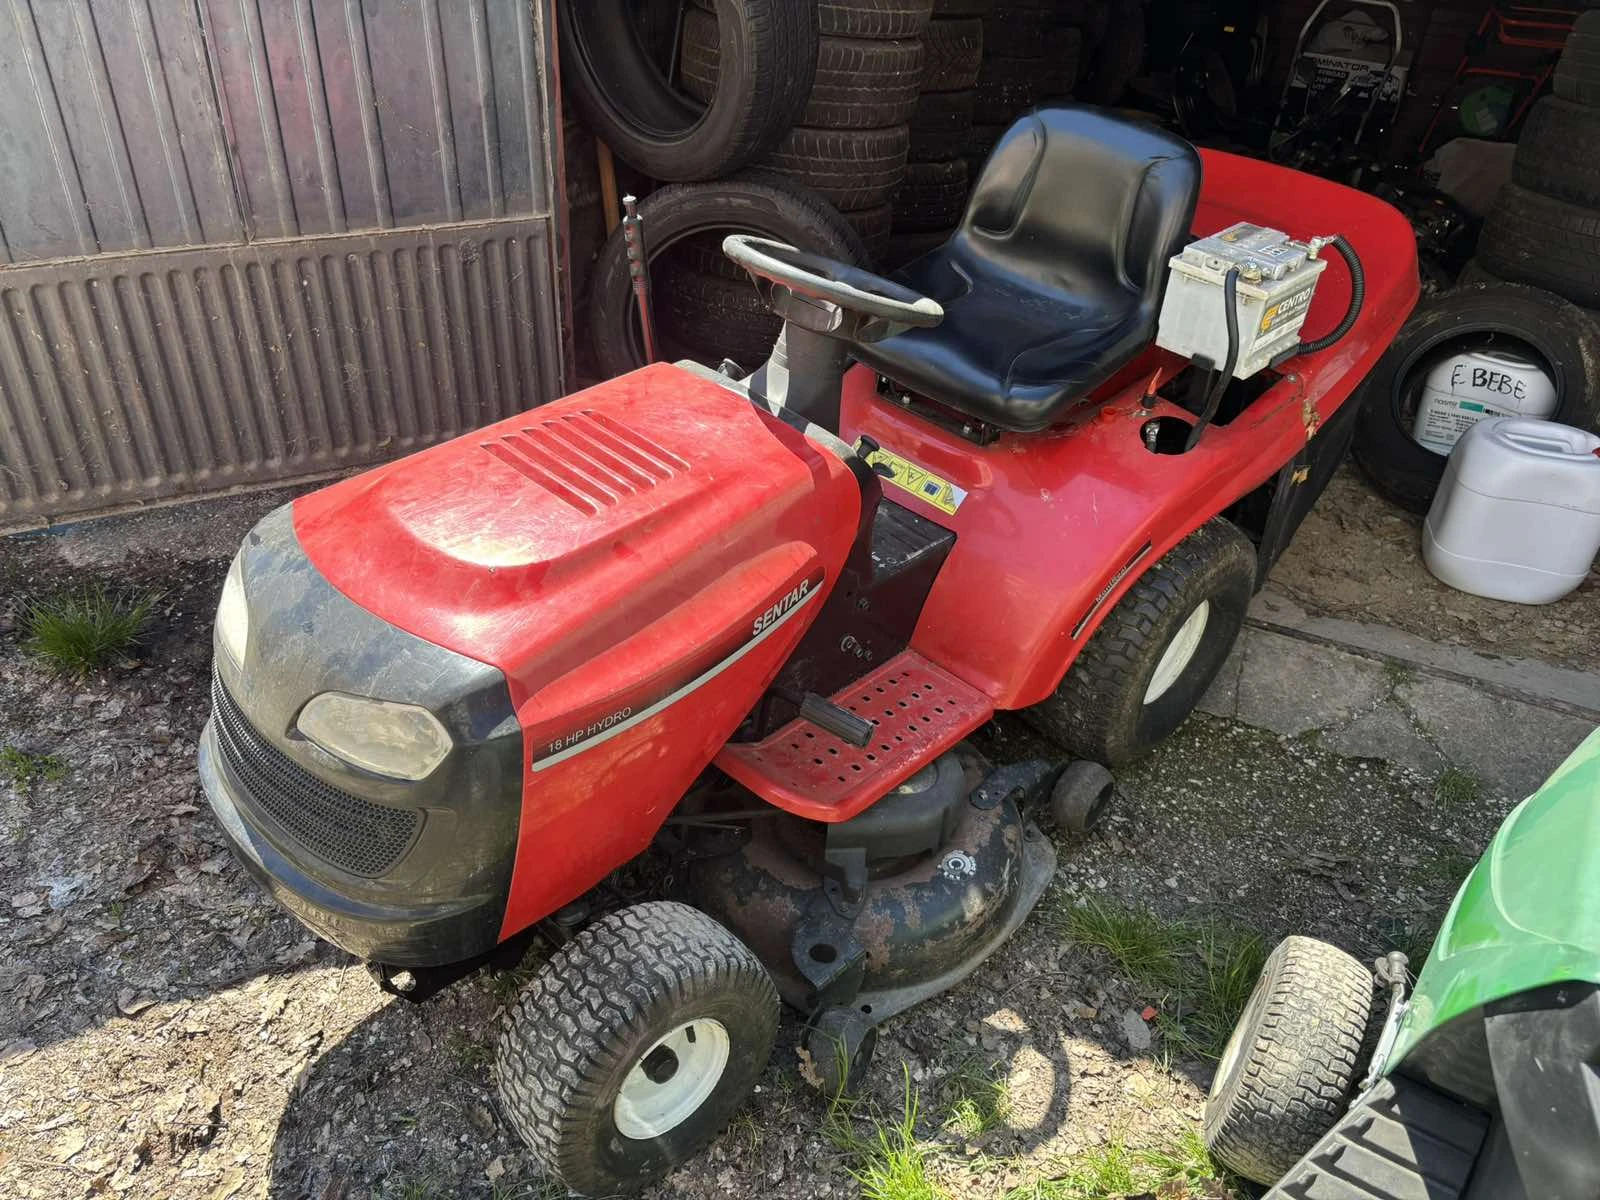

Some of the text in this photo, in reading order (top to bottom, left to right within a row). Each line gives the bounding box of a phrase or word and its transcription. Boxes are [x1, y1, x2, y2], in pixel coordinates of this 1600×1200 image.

[1278, 287, 1311, 314] CENTRO
[1471, 367, 1527, 400] BEBE
[753, 579, 809, 636] SENTAR
[549, 706, 632, 753] 18 HP HYDRO
